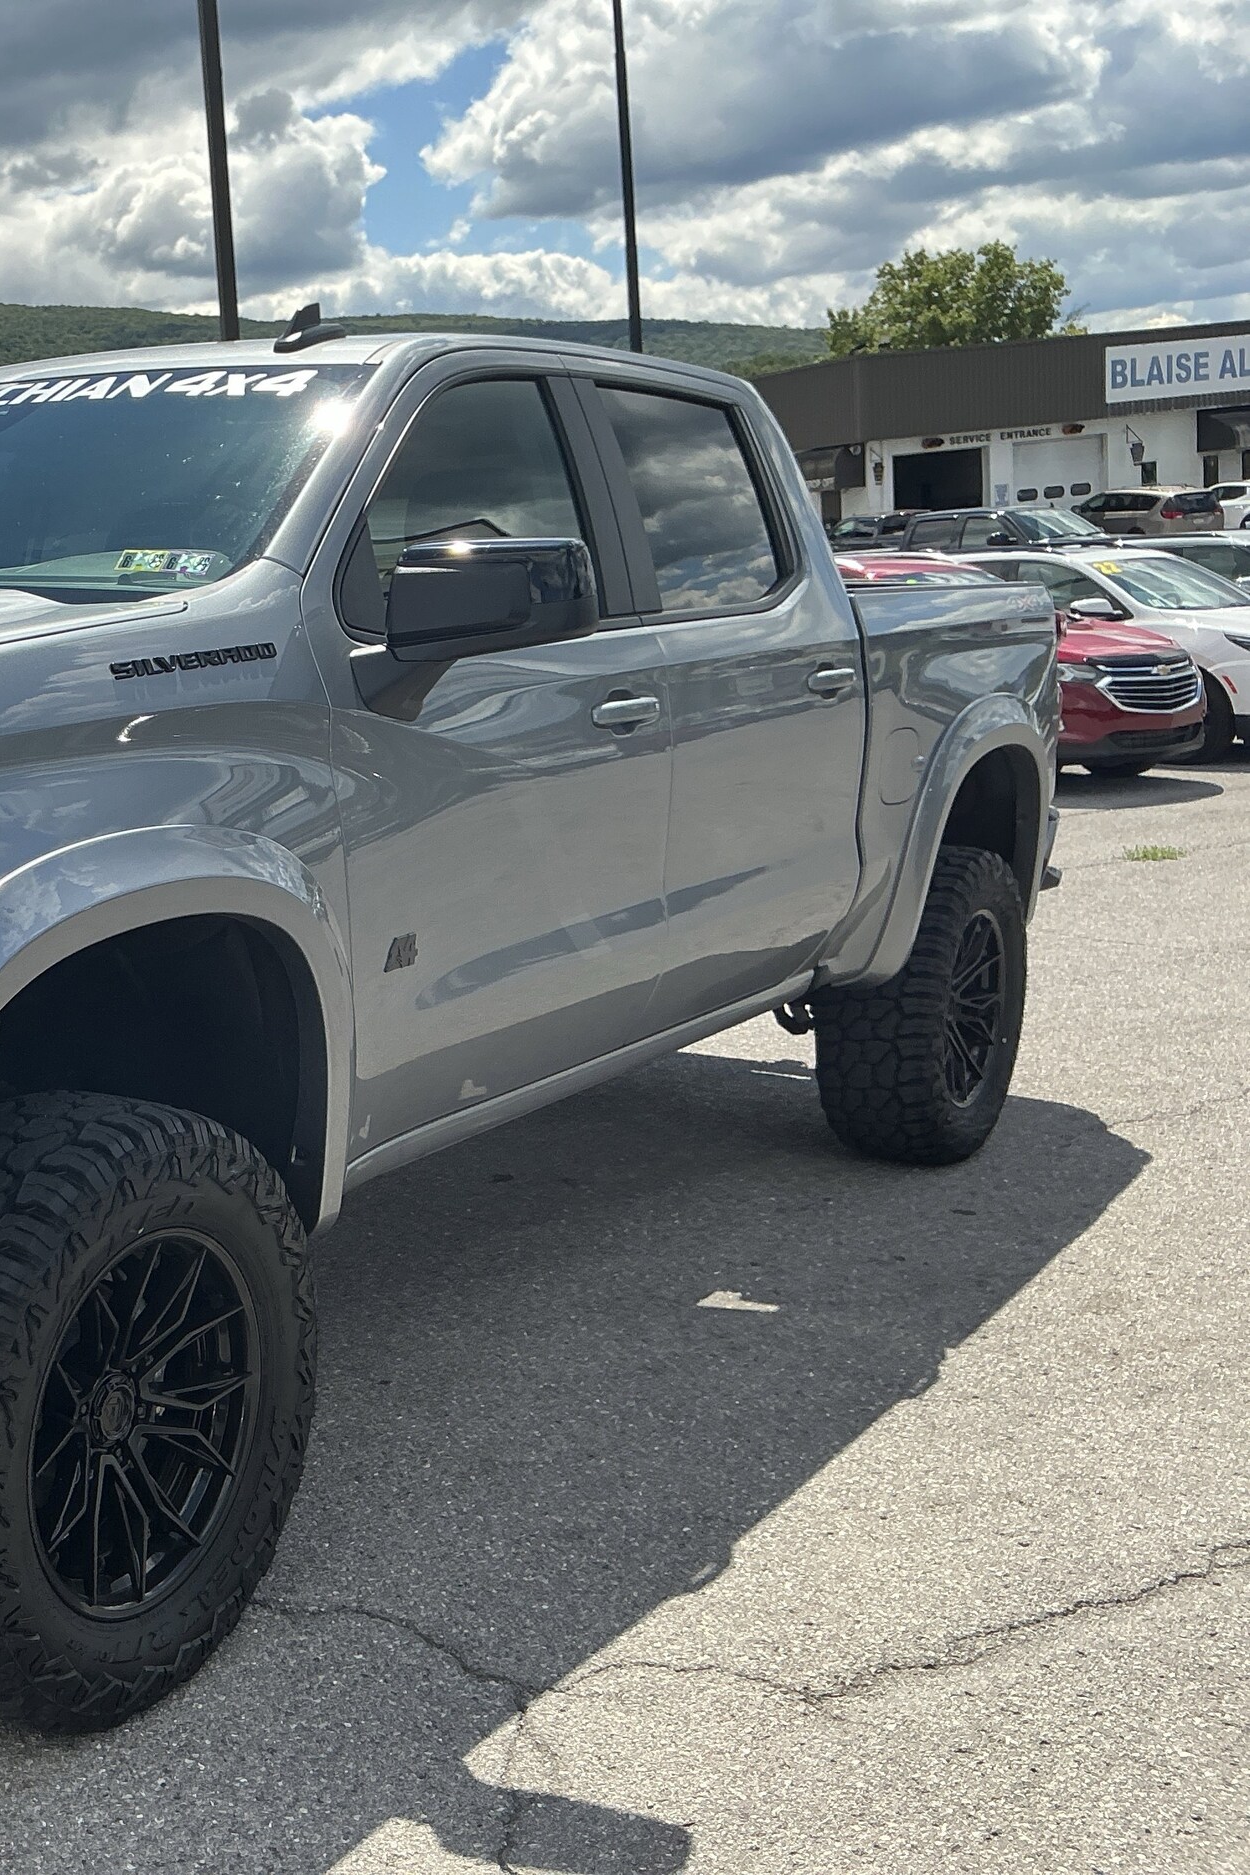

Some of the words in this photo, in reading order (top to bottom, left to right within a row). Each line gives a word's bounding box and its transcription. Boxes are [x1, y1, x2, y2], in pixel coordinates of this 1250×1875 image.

[1111, 351, 1210, 389] BLAISE
[949, 433, 991, 446] SERVICE
[1000, 428, 1052, 441] ENTRANCE
[109, 642, 278, 681] SILVERADO
